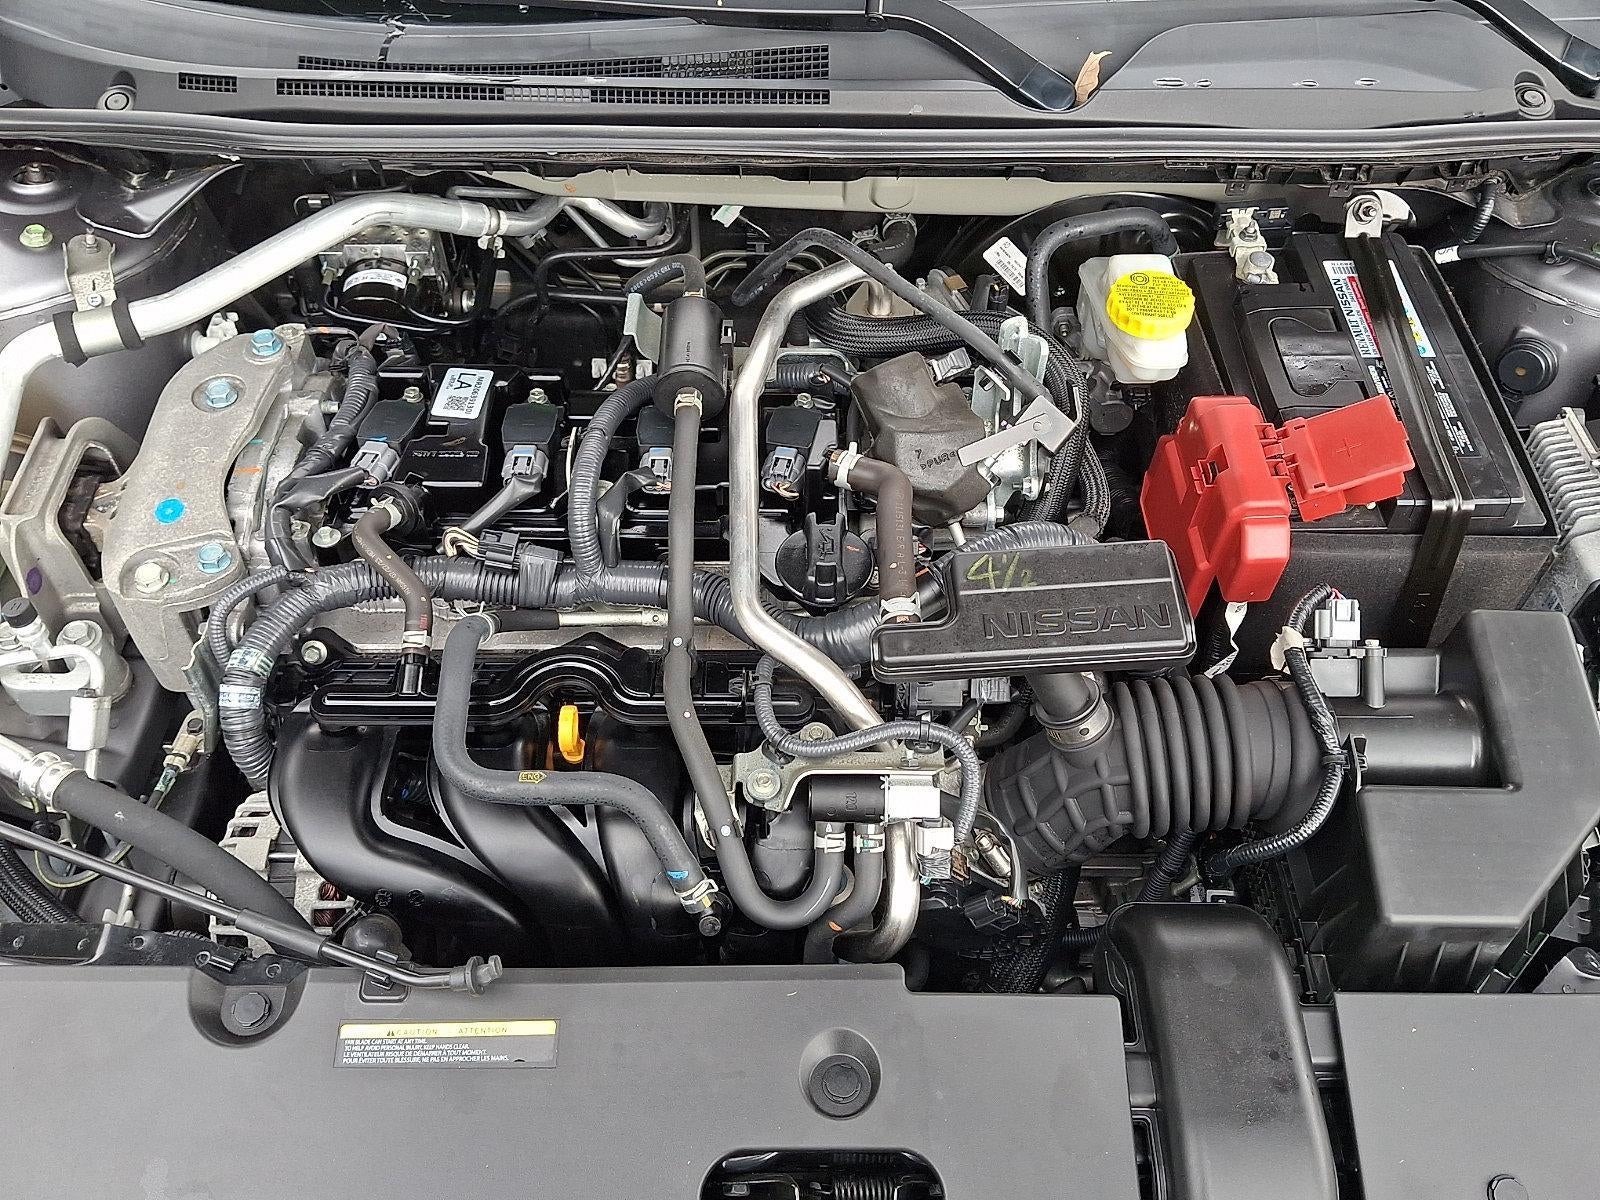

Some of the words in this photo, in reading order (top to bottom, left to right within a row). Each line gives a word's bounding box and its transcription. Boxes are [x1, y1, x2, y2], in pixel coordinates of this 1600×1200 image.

[1331, 278, 1355, 317] NISSAN
[1348, 319, 1371, 355] RENAULT
[453, 372, 477, 390] LA
[981, 602, 1172, 640] NISSAN
